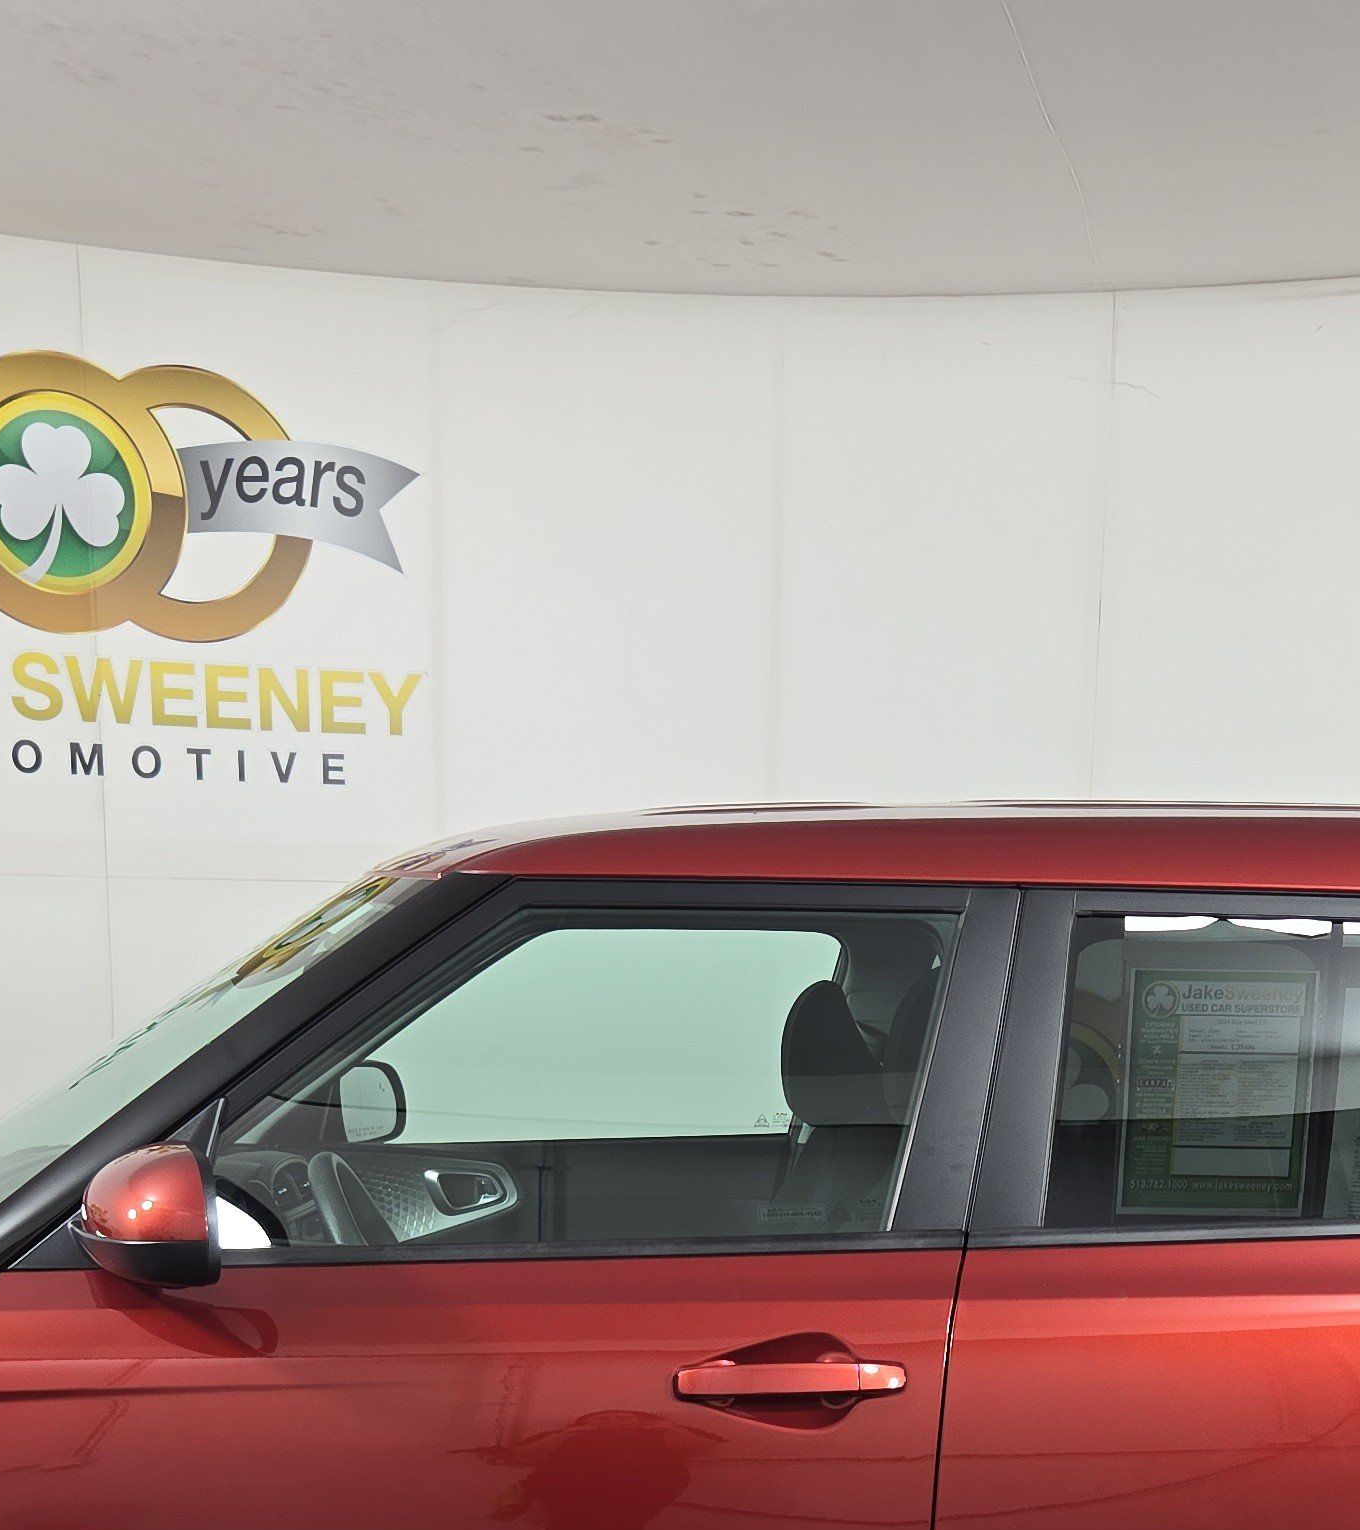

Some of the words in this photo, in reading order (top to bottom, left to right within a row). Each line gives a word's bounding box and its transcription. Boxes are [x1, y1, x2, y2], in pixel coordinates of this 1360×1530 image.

[199, 451, 367, 521] years
[10, 651, 423, 737] SWEENEY
[1181, 1003, 1209, 1013] USED
[1211, 1003, 1232, 1013] CAR
